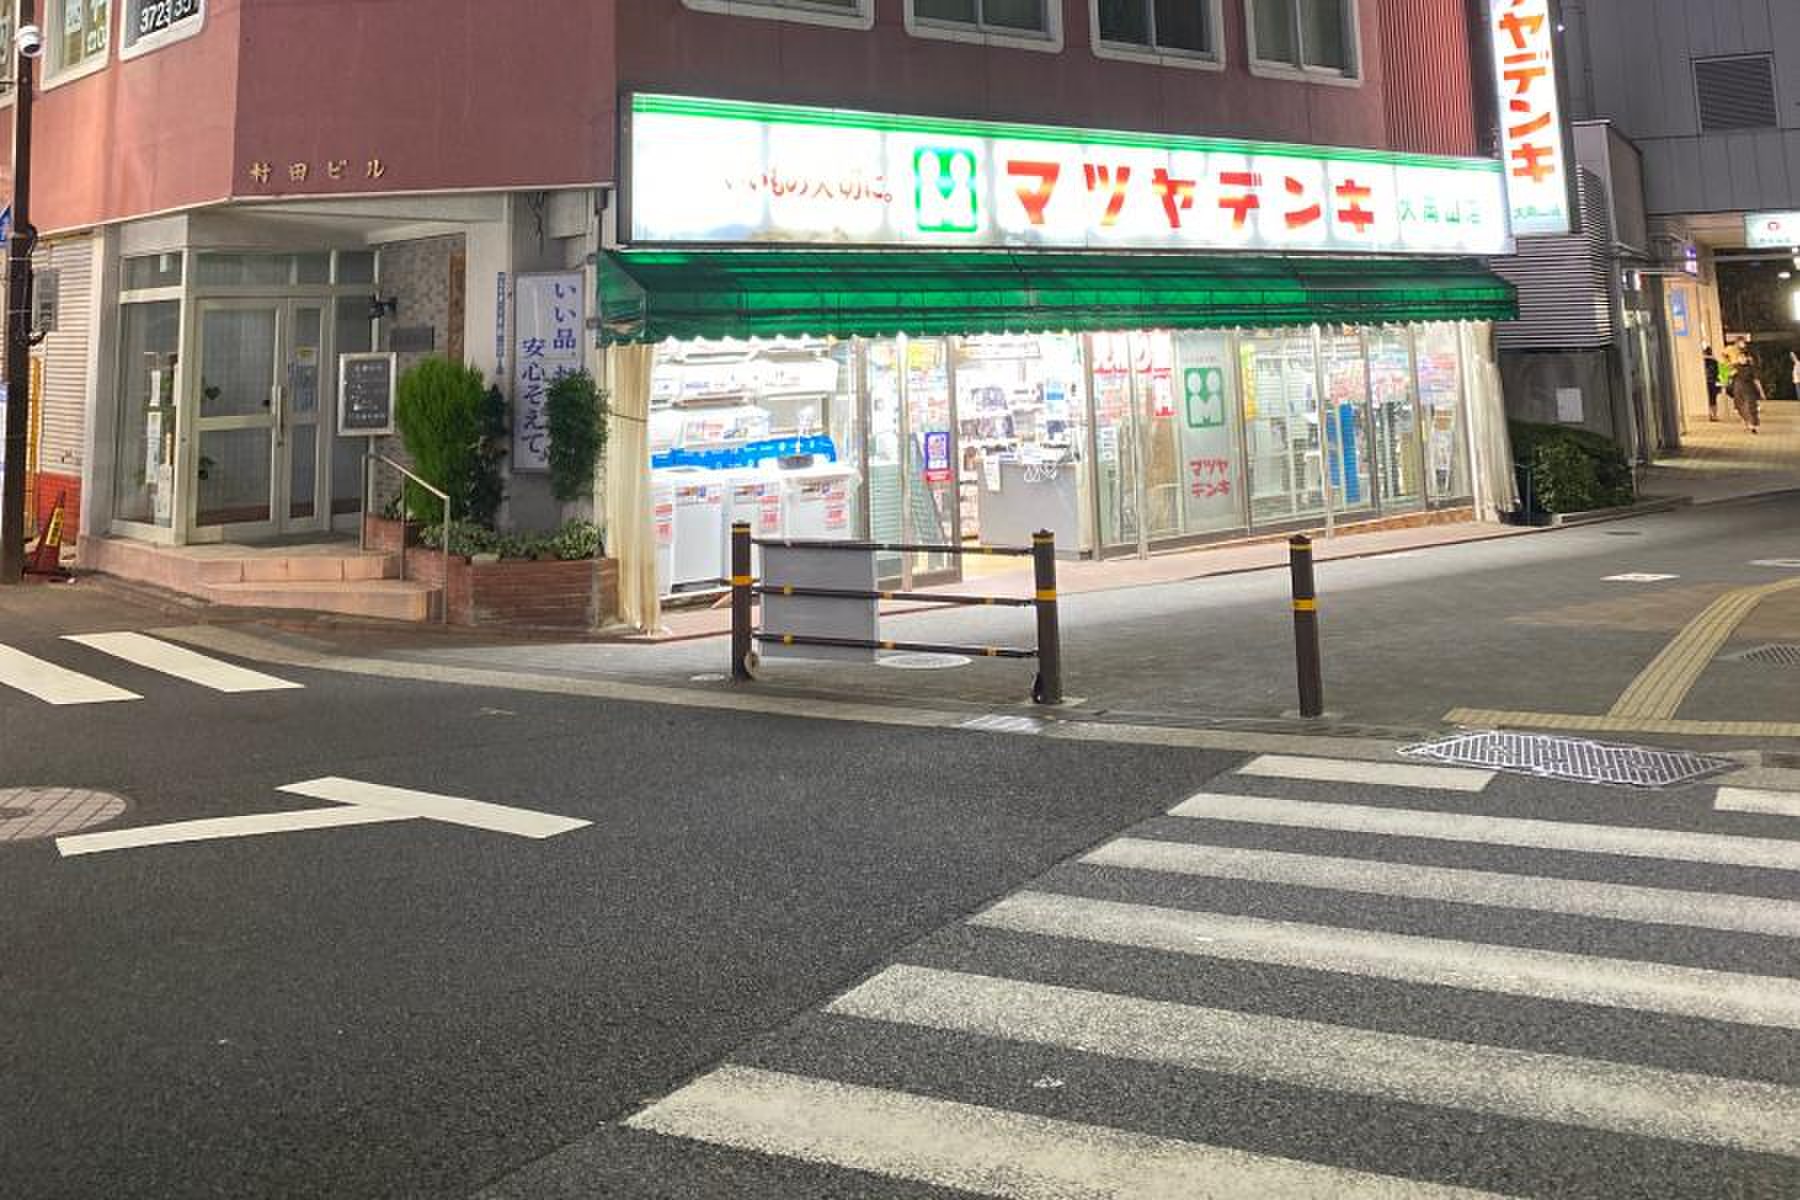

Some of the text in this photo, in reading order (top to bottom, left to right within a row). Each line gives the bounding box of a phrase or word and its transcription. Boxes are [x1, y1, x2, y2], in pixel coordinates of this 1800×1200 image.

[1007, 160, 1374, 233] マツヤデンキ
[1189, 458, 1229, 479] マツヤ
[1191, 479, 1231, 499] デンキ
